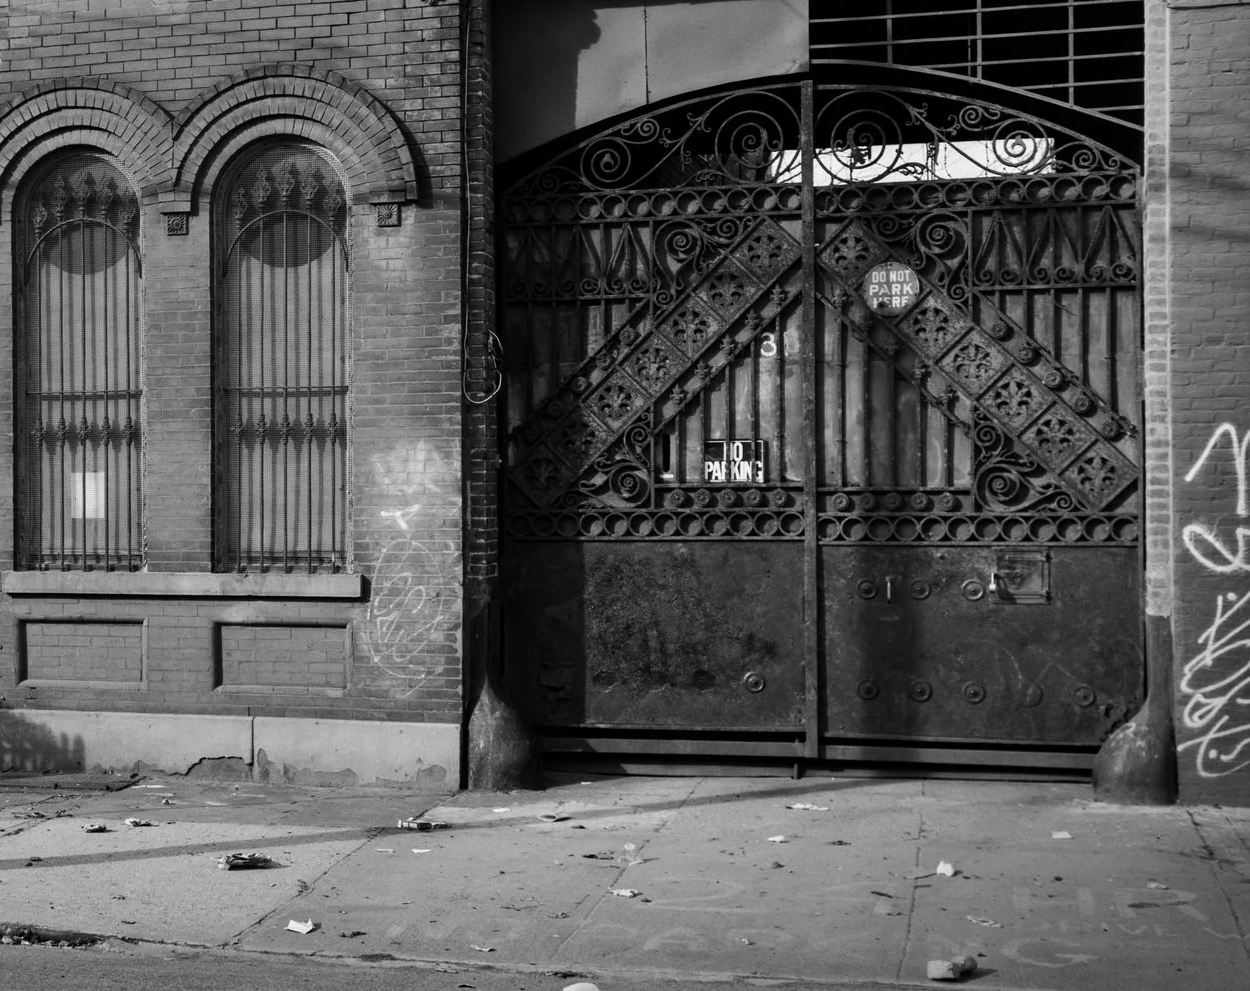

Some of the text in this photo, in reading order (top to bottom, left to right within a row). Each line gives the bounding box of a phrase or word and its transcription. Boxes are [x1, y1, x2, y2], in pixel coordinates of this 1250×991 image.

[872, 270, 910, 283] DO NOT
[869, 283, 913, 296] PARK
